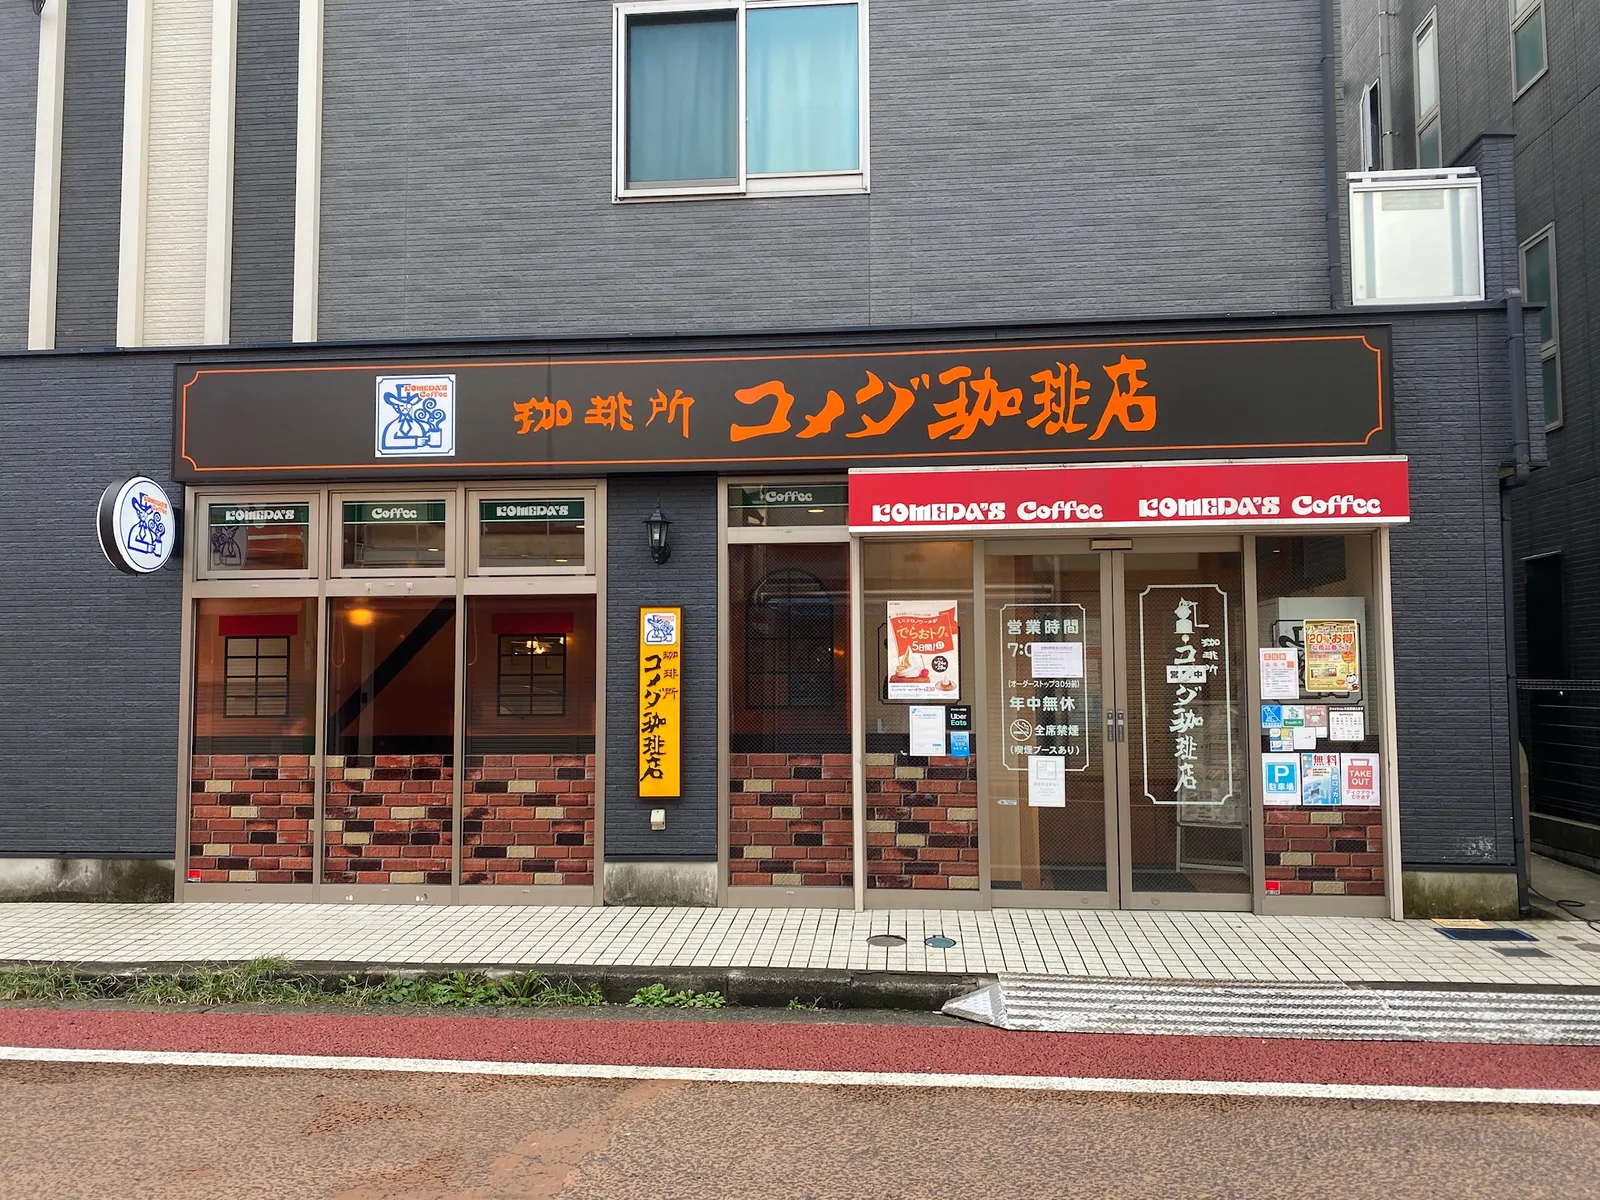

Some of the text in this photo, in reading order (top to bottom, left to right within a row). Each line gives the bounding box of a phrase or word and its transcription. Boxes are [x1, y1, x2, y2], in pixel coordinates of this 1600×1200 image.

[730, 354, 1157, 442] コメダ珈琲店
[513, 388, 695, 439] 珈琲所
[765, 491, 813, 503] Coffee
[371, 506, 418, 520] Coffee
[495, 504, 570, 518] KOMEDA'S
[872, 500, 1104, 522] KOMEDA'S Coffee
[1138, 494, 1382, 518] KOMEDA'S Coffee
[225, 509, 295, 521] KOMEDA'S
[1006, 618, 1080, 636] 営業時間
[662, 650, 679, 700] 珈琲所
[1170, 670, 1203, 679] 営中
[1007, 679, 1080, 689] (オーダーストップ30分前)
[1009, 695, 1076, 712] 年中無休
[639, 653, 667, 782] コメダ珈琲店
[1034, 724, 1080, 737] 全席禁煙
[1009, 745, 1081, 756] （喫煙ブースあり）
[1313, 754, 1337, 766] 無料
[1274, 765, 1290, 783] P
[1349, 770, 1372, 778] TAKE
[1268, 782, 1295, 792] 駐車場
[1351, 777, 1370, 786] OUT
